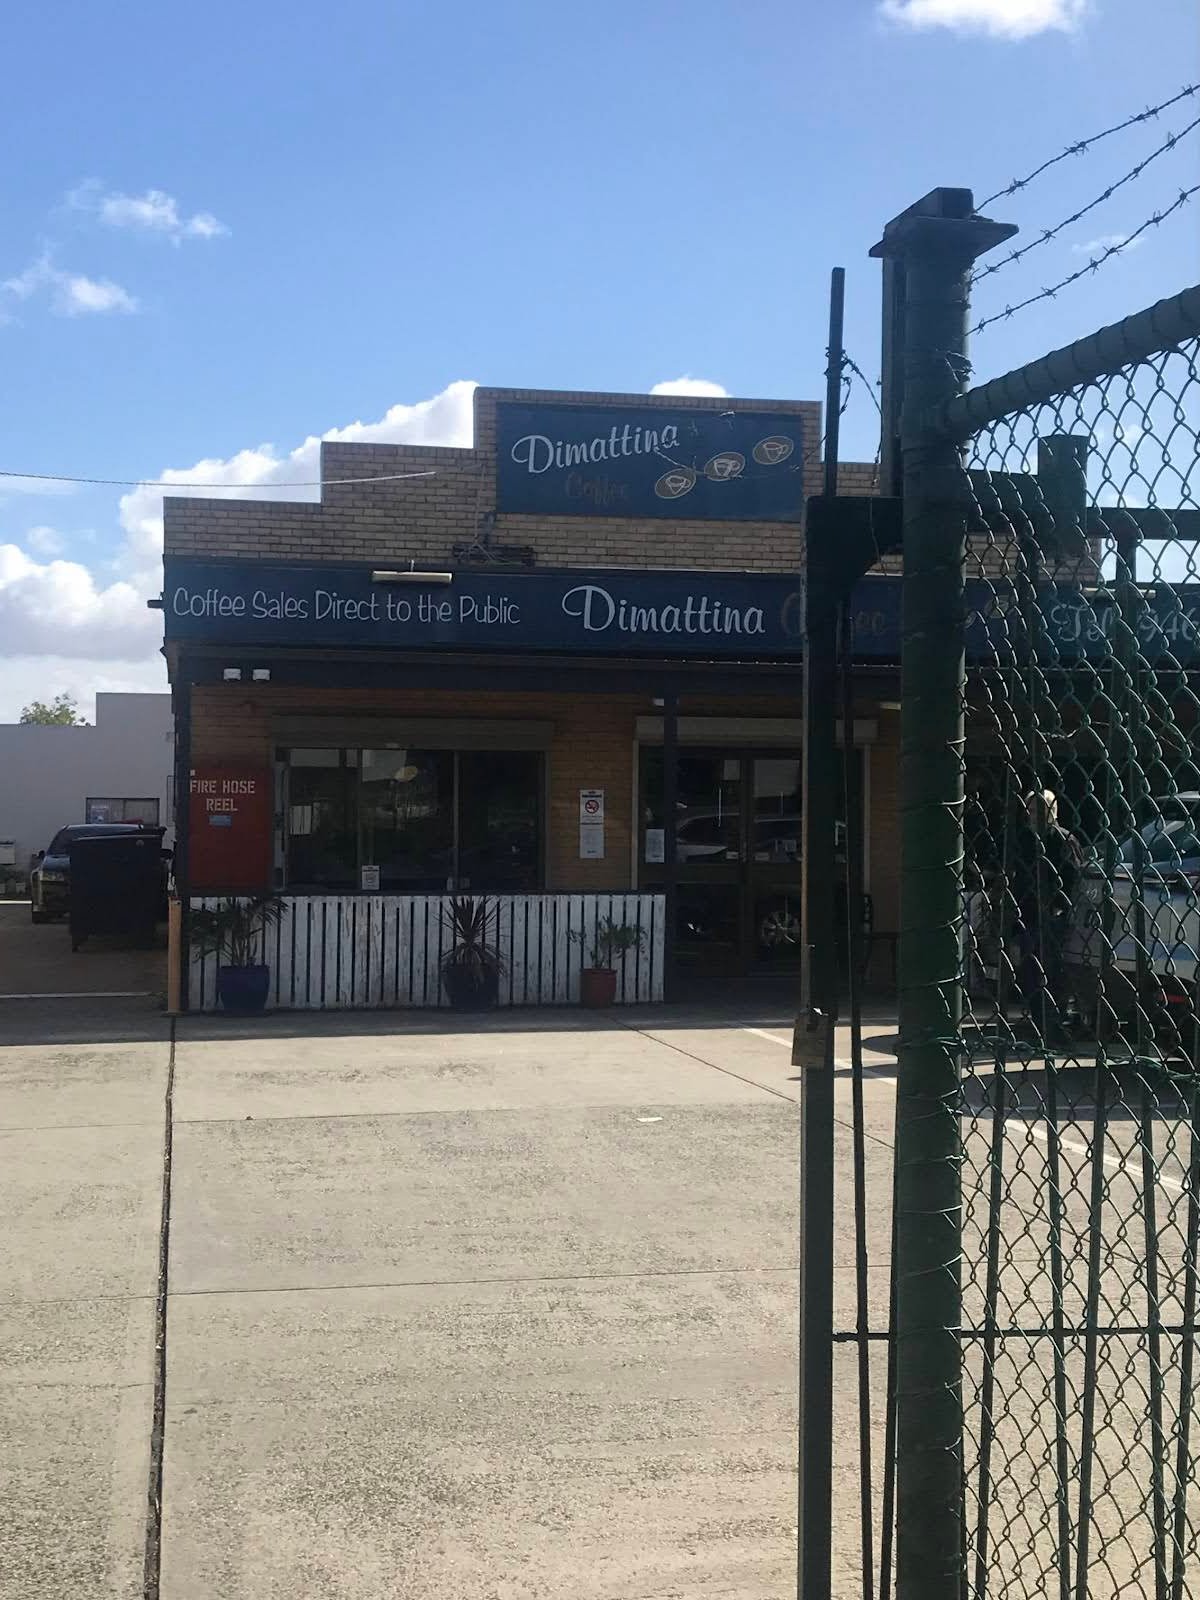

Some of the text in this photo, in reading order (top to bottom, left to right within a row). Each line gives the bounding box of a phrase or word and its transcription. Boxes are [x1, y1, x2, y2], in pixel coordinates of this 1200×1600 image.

[511, 424, 680, 474] Dimattina
[172, 588, 521, 624] Coffee Sales Direct to the Public
[562, 586, 766, 633] Dimattina
[190, 780, 256, 794] FIRE HOSE
[207, 798, 238, 811] REEL
